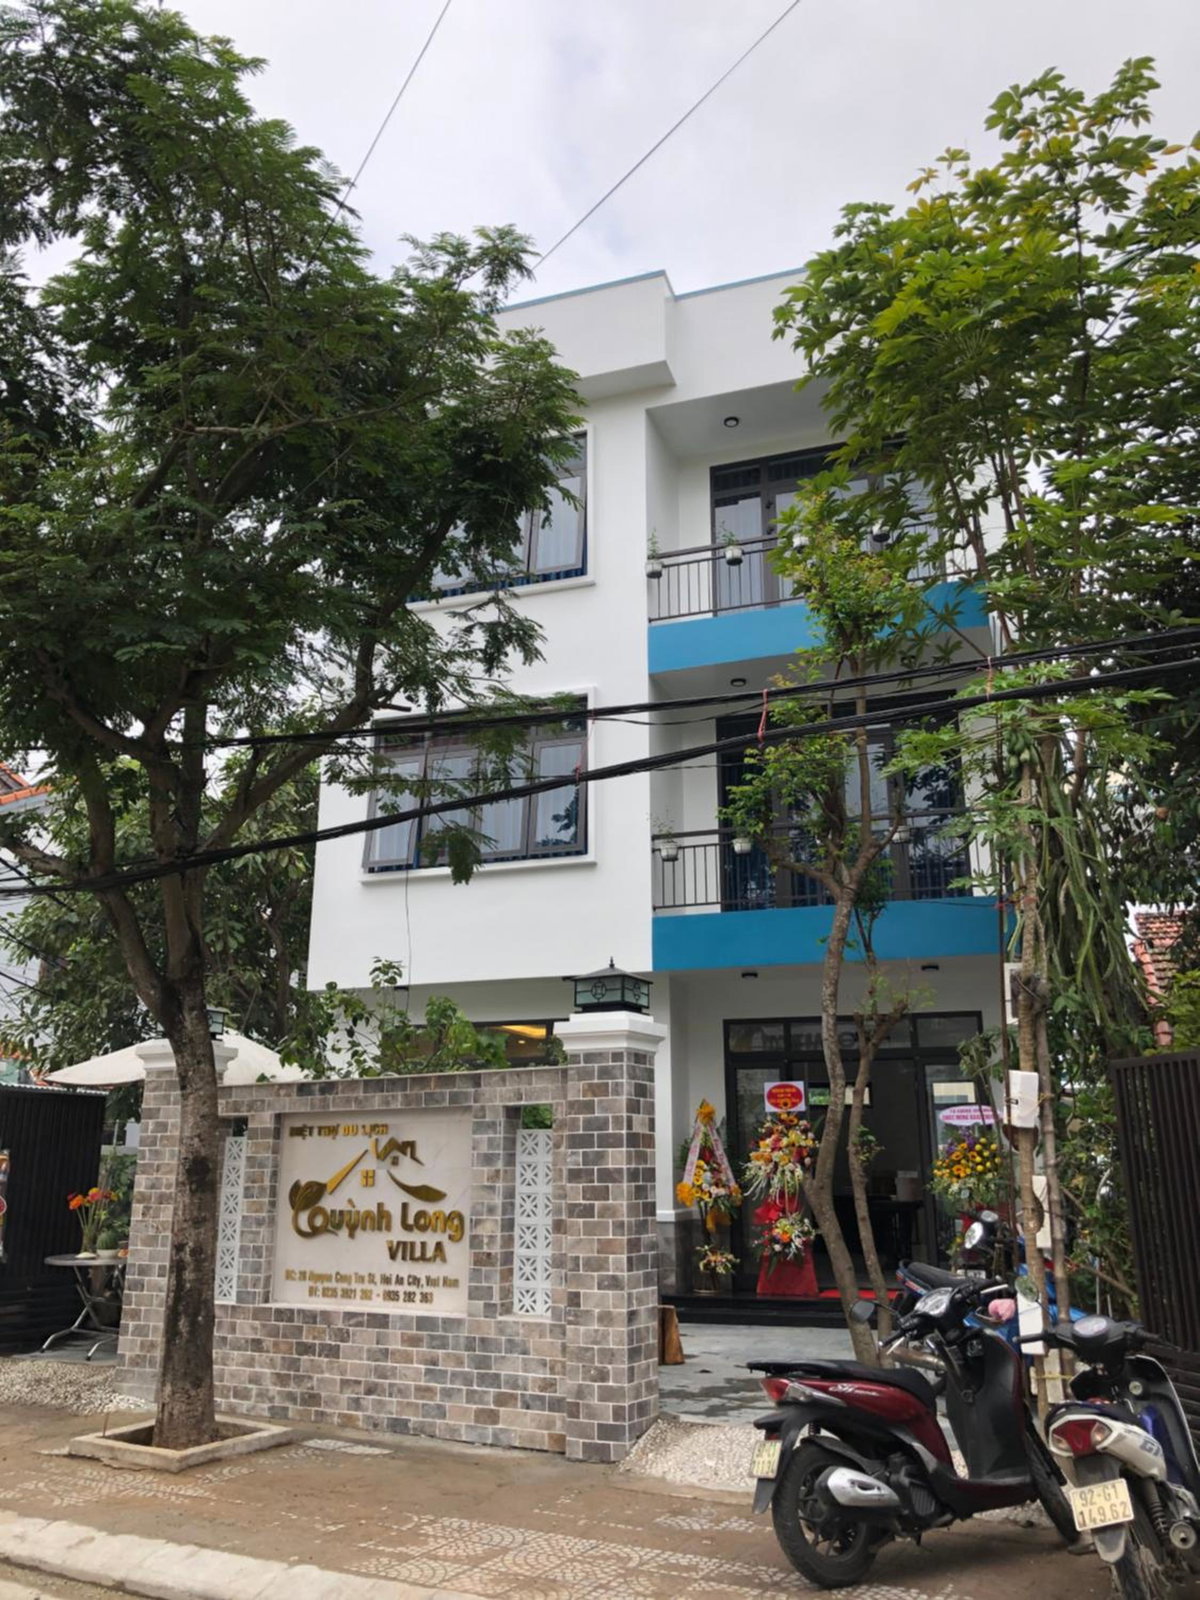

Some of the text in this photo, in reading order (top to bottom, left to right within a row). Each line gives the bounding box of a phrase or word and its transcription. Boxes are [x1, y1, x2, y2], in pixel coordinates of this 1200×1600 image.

[294, 1198, 465, 1242] Quỳnh Long
[387, 1240, 447, 1264] VILLA
[1079, 1483, 1120, 1508] 92-G1
[1078, 1501, 1131, 1529] 149.62
